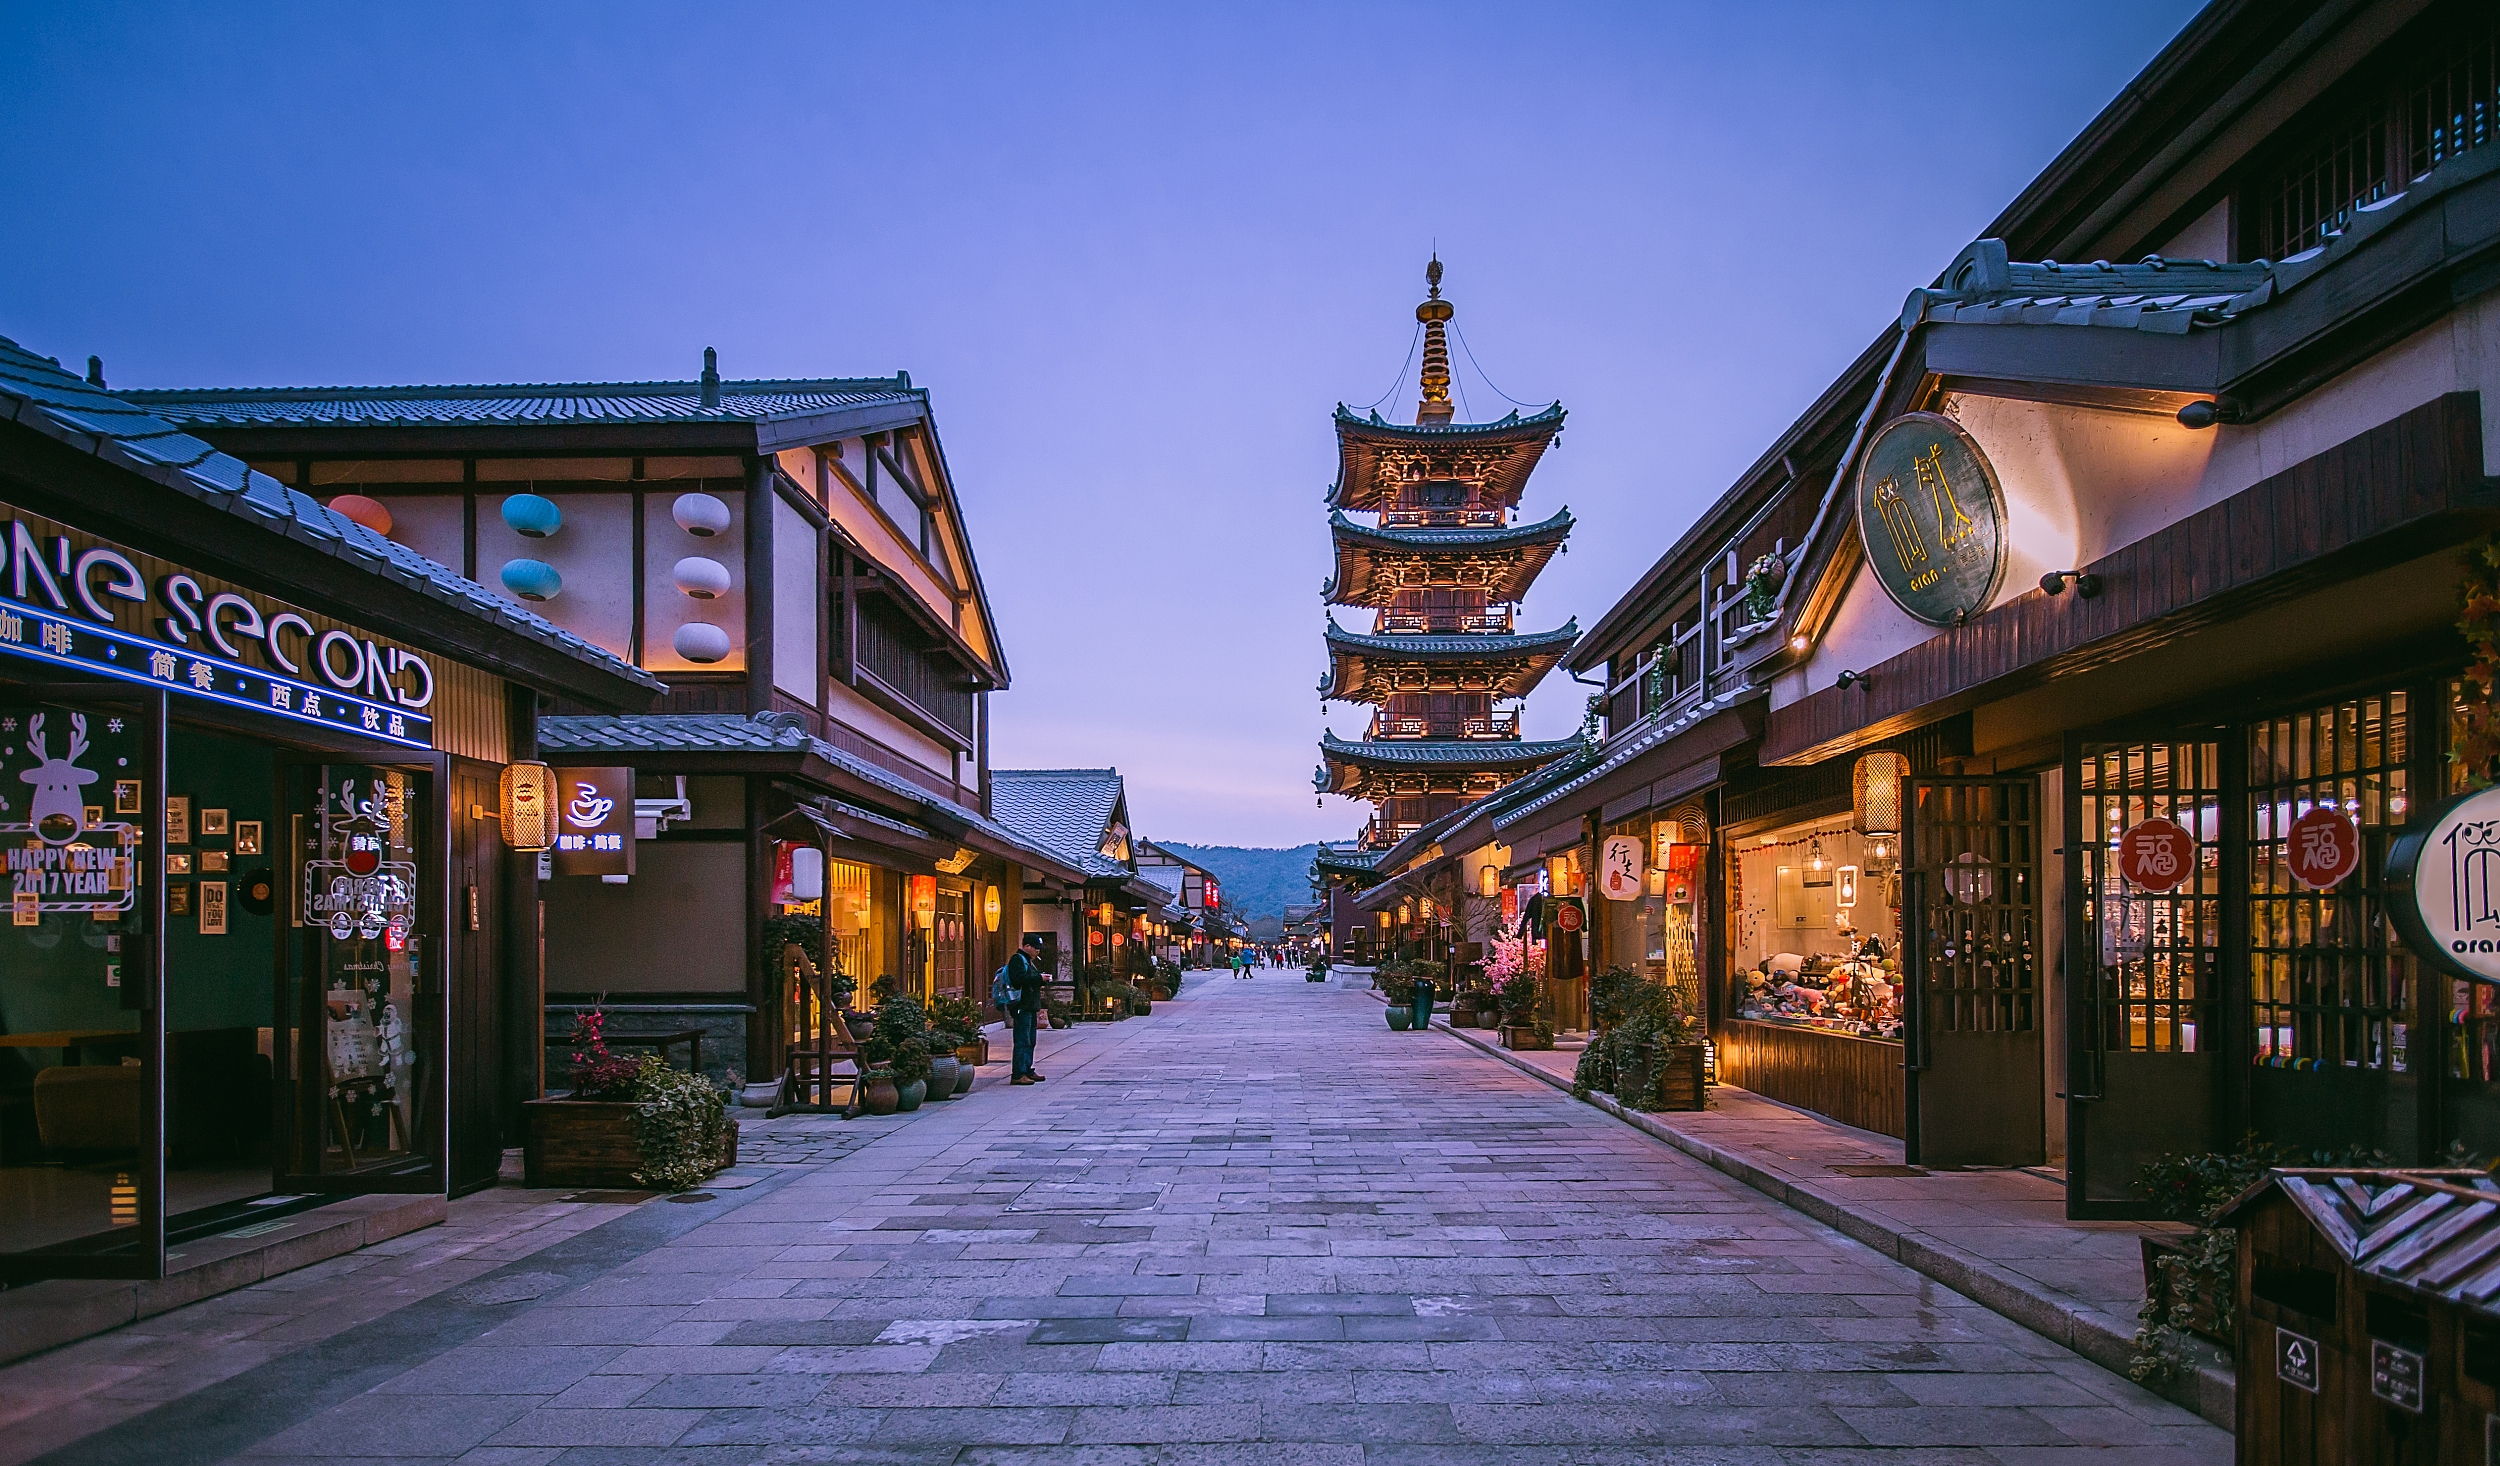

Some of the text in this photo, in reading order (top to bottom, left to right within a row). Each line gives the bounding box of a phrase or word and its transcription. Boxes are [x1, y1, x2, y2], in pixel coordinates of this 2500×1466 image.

[2136, 835, 2178, 877] 福
[2300, 822, 2341, 870] 福
[7, 847, 117, 870] HAPPY NEW
[13, 872, 110, 895] 2017 YEAR
[207, 888, 223, 903] DO
[207, 909, 223, 918] YOU
[207, 918, 223, 926] LOVE
